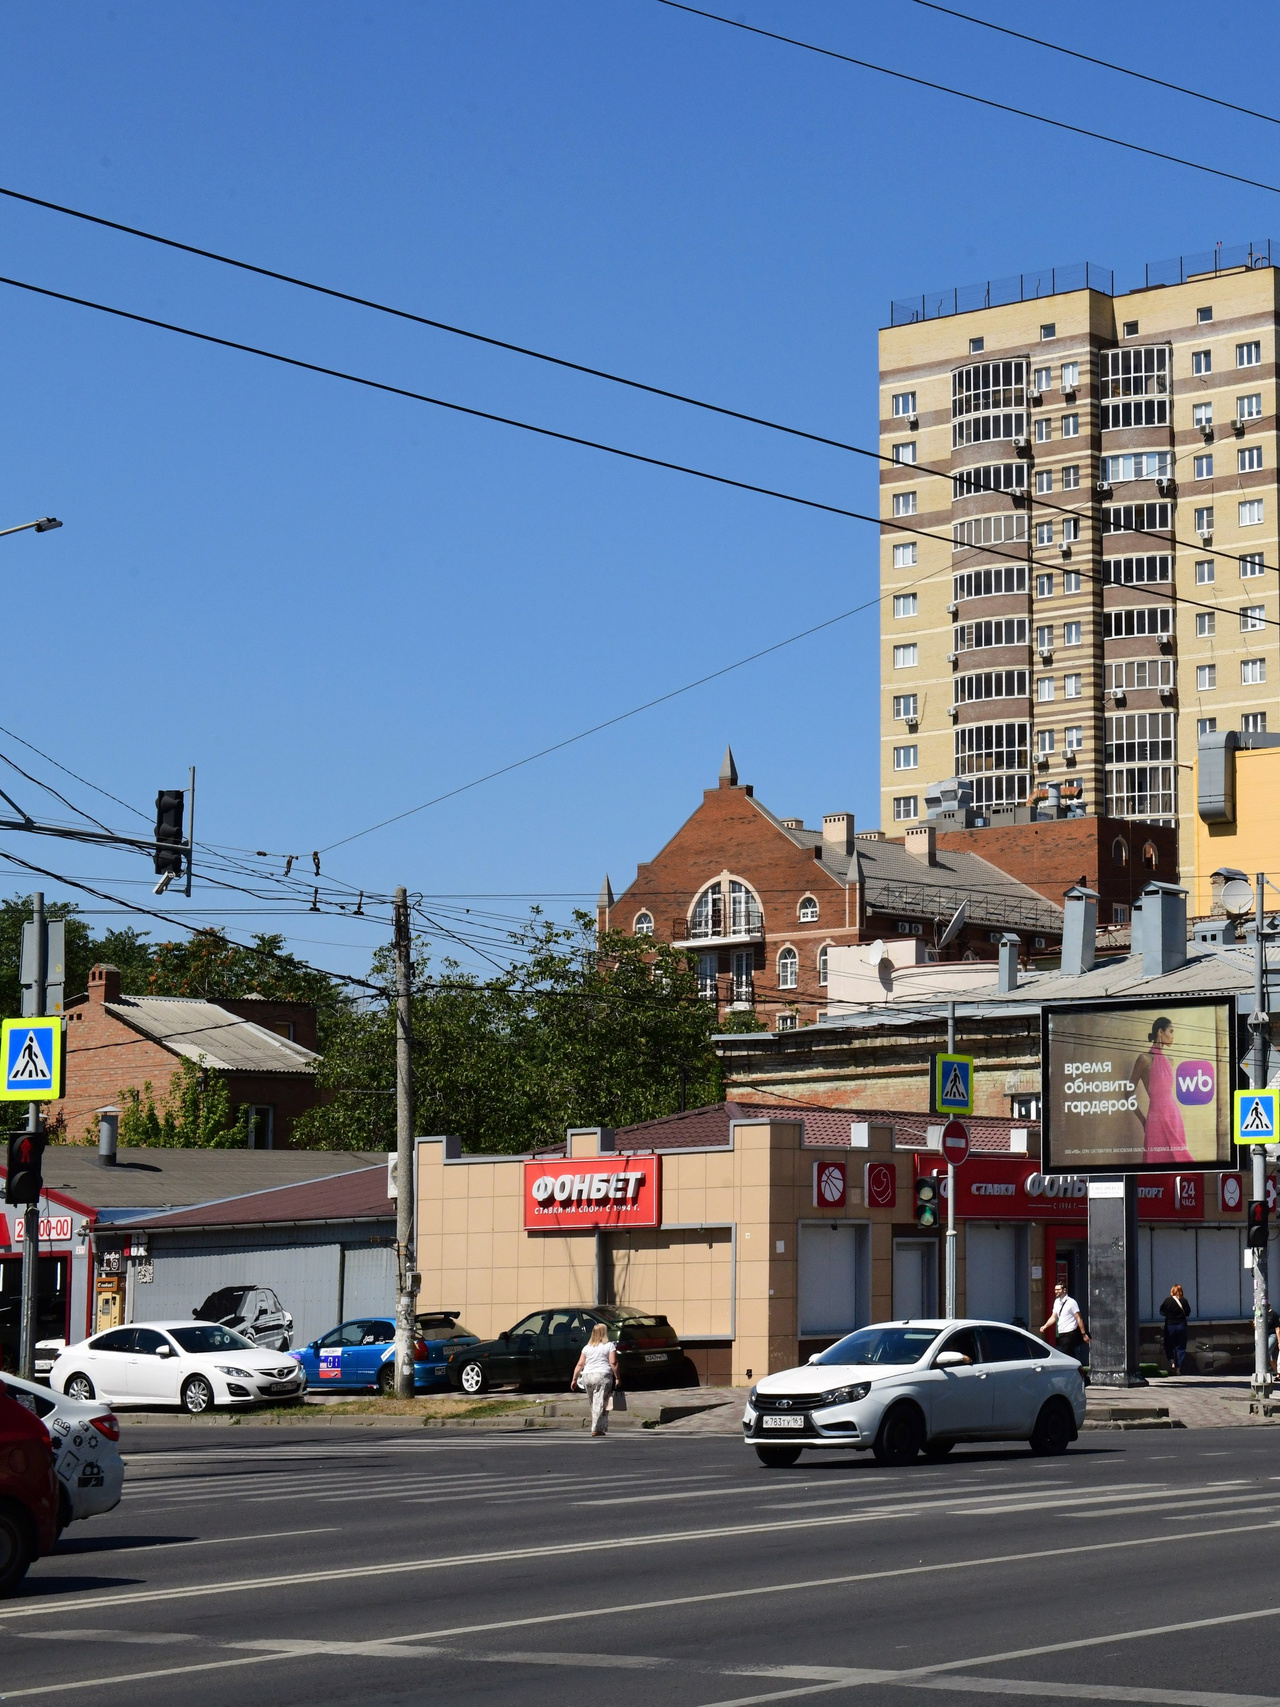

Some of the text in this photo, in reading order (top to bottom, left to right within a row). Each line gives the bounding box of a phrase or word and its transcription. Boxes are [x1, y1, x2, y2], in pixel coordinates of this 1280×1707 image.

[1064, 1061, 1112, 1078] время
[1064, 1078, 1135, 1094] обновить
[1178, 1069, 1213, 1092] wb
[1064, 1095, 1138, 1116] гардероб
[532, 1171, 645, 1202] ФОНБЕТ
[971, 1172, 1164, 1198] СТАВКИ ФОНБ ПОРТ
[1182, 1181, 1195, 1198] 24
[534, 1206, 563, 1215] СТАВКИ
[565, 1206, 576, 1214] НА
[579, 1205, 603, 1213] СПОРТ
[613, 1204, 631, 1212] 1994
[1181, 1199, 1196, 1207] ЧАСА
